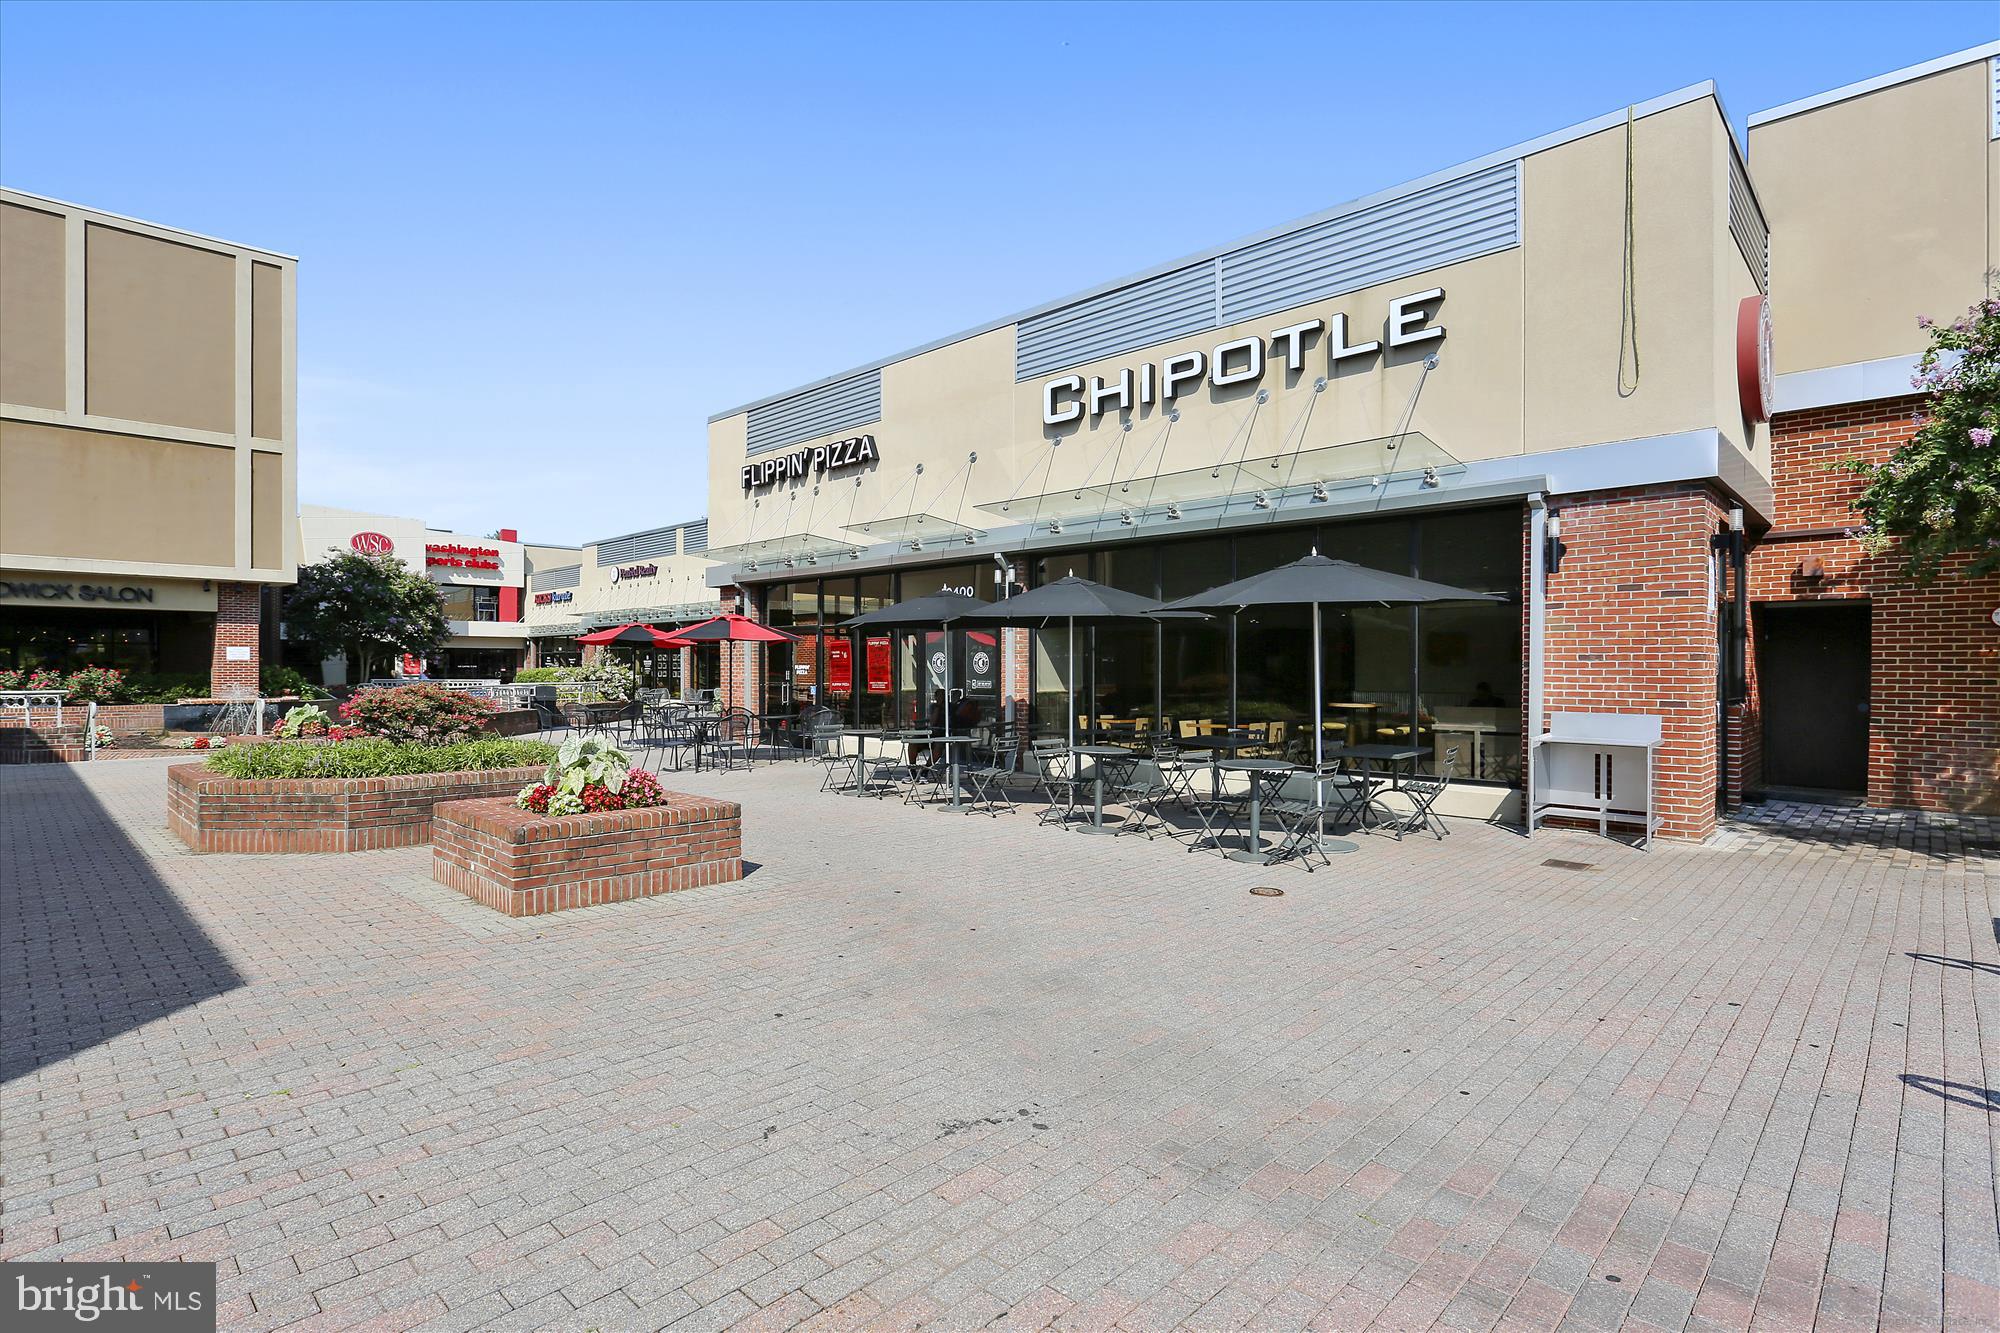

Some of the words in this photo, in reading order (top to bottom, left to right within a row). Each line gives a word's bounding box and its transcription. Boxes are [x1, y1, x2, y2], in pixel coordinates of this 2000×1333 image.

[1043, 287, 1446, 425] CHIPOTLE
[741, 447, 811, 489] FLIPPIN'
[813, 435, 877, 472] PIZZA
[355, 533, 389, 554] WSC
[426, 556, 463, 567] ports
[464, 558, 500, 570] clubs
[78, 584, 154, 603] SALON
